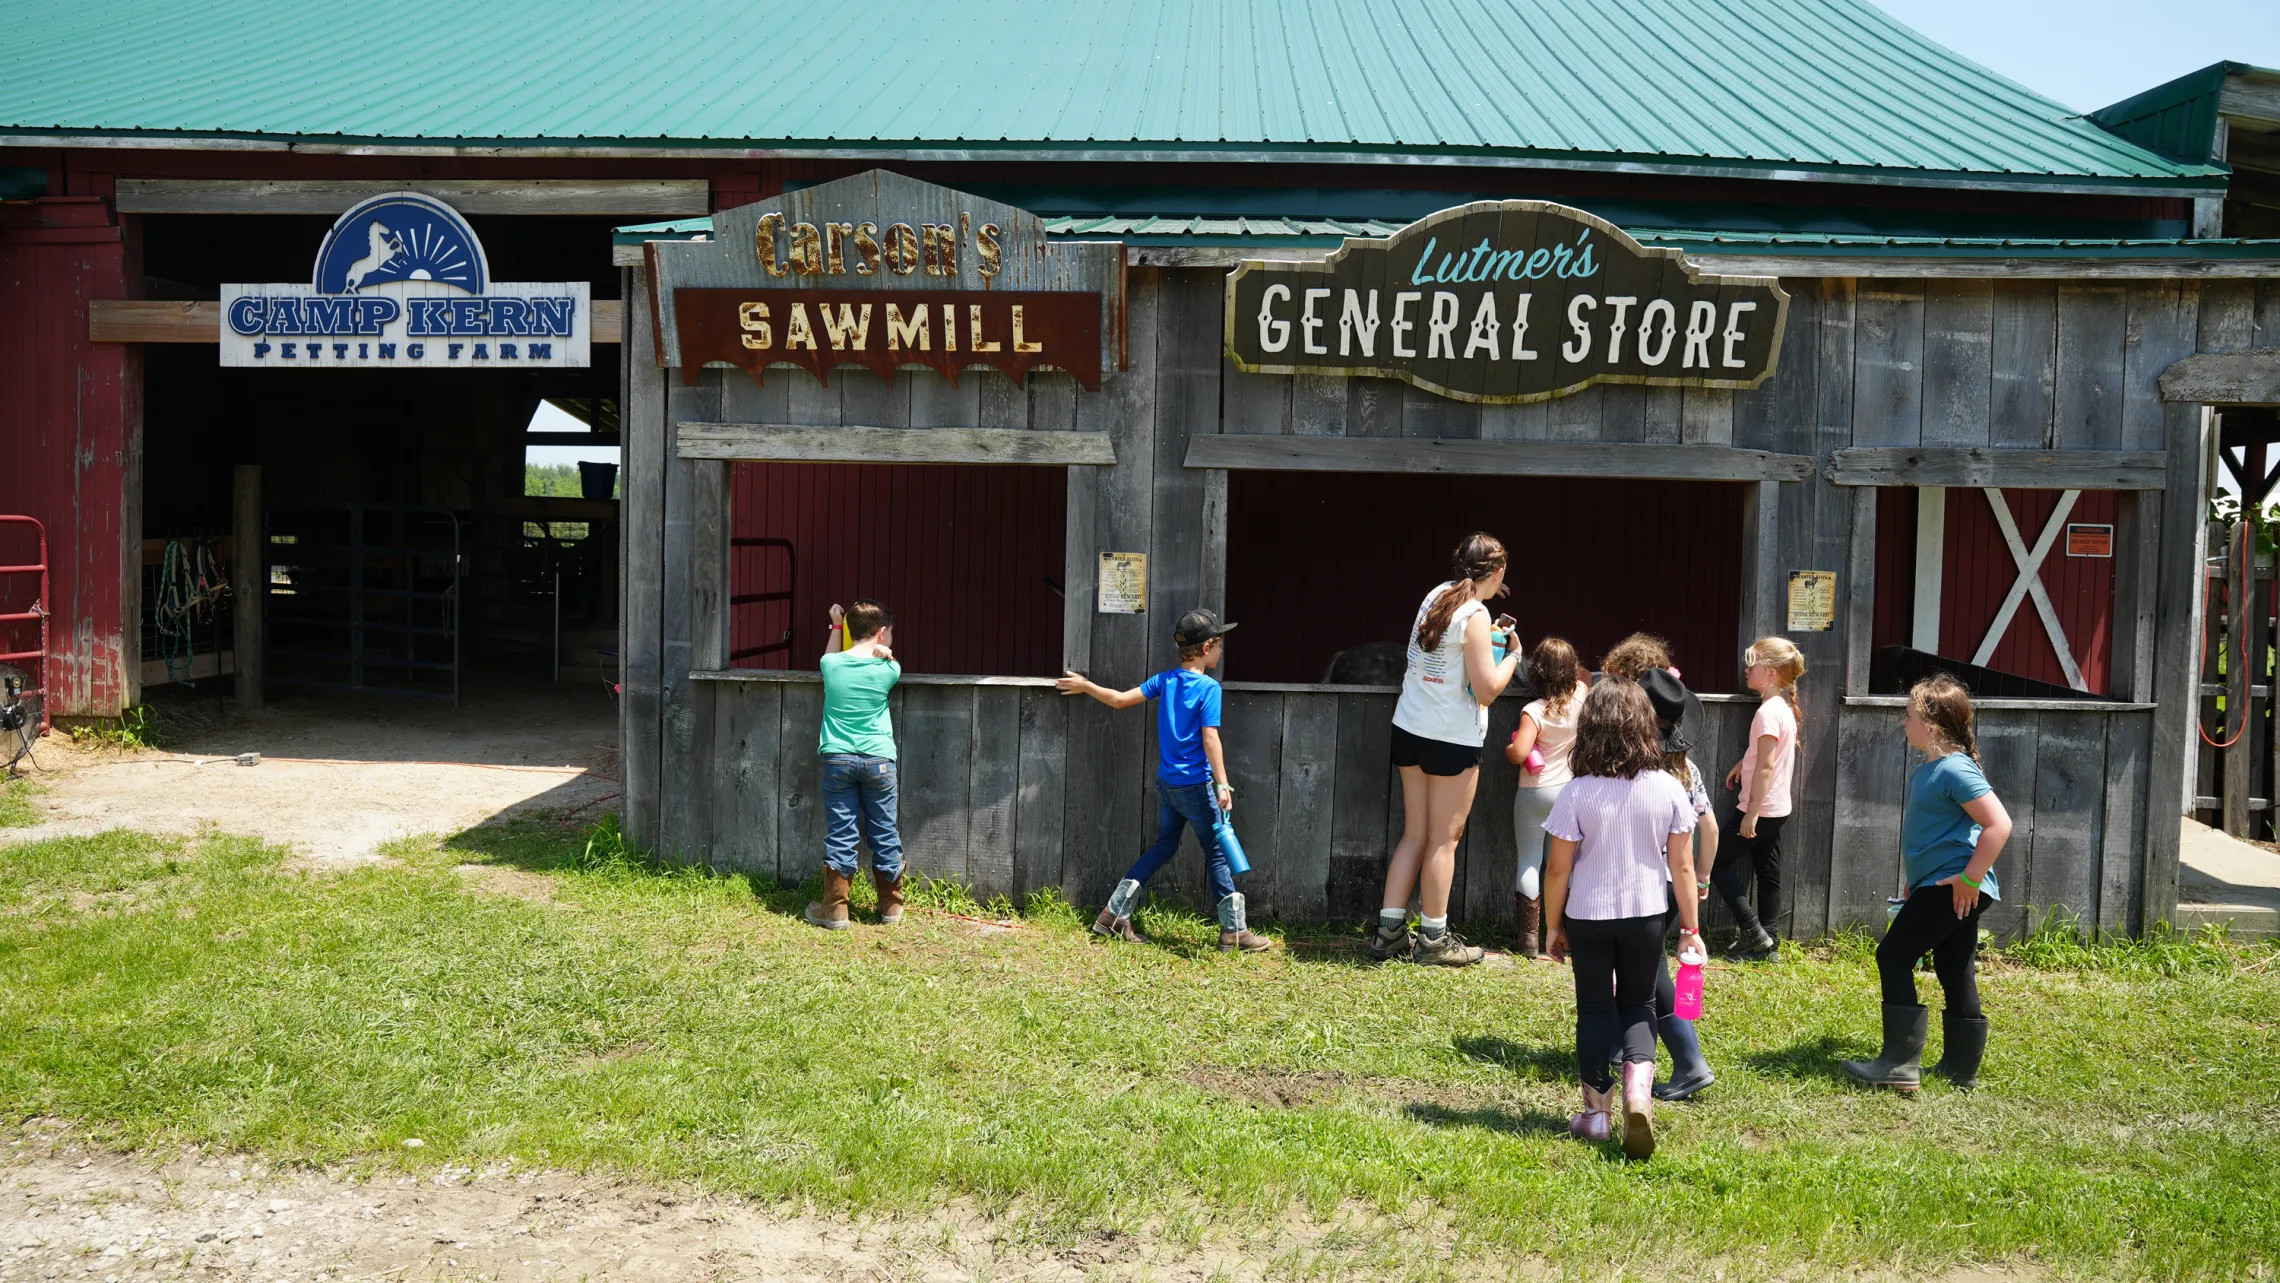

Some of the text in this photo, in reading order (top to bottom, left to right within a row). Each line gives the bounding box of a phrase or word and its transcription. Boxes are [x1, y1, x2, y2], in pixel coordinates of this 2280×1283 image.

[755, 211, 1003, 277] Carson's
[1411, 228, 1600, 286] Lutmer's
[227, 296, 575, 337] CAMP KERN
[738, 302, 1043, 353] SAWMILL
[1258, 284, 1757, 369] GENERAL STORE
[253, 343, 552, 360] PETTING FARM
[1423, 676, 1444, 684] 2025
